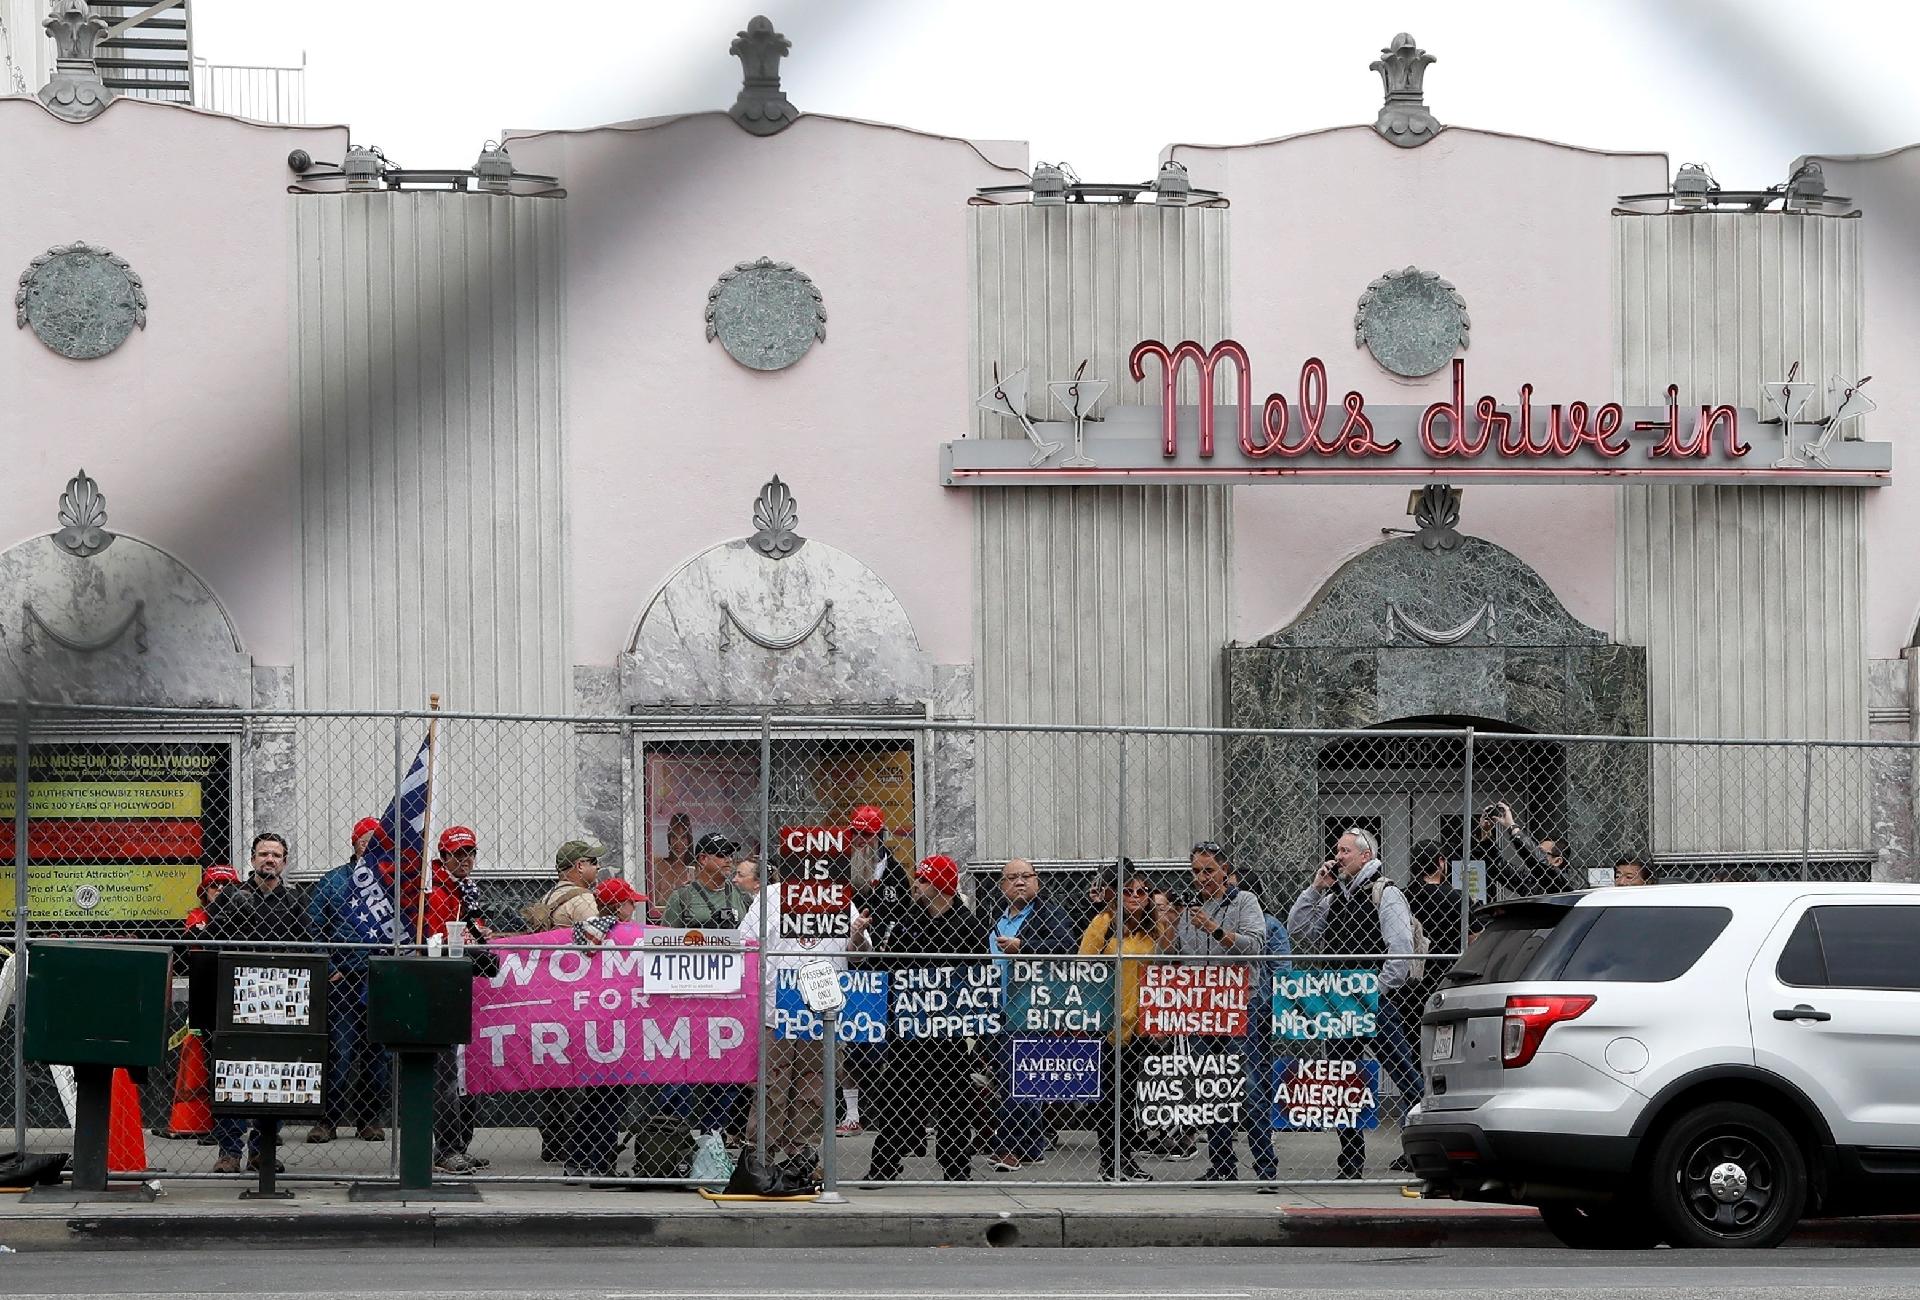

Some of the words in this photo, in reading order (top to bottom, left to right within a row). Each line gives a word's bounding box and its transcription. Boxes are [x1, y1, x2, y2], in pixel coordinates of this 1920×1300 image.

[1129, 339, 1402, 459] Mels
[1418, 358, 1753, 459] drive-in
[50, 755, 107, 768] MUSEUM
[111, 755, 128, 768] OF
[142, 769, 165, 778] Mayor
[37, 789, 88, 798] AUTHENTIC
[90, 789, 131, 798] SHOWBIZ
[134, 789, 184, 798] TREASURES
[51, 802, 68, 810] 100
[70, 802, 98, 810] YEARS
[100, 802, 112, 810] OF
[787, 830, 843, 853] CNN
[54, 871, 84, 879] Tourist
[156, 870, 186, 879] Weekly
[804, 858, 829, 880] IS
[31, 895, 65, 903] Tourism
[136, 894, 161, 902] Board
[45, 885, 54, 893] of
[787, 884, 843, 906] FAKE
[53, 909, 61, 917] of
[122, 909, 139, 918] Trip
[782, 913, 849, 935] NEWS
[651, 935, 731, 947] CALIFORNIANS
[650, 954, 733, 981] 4TRUMP
[802, 966, 833, 981] PASSENGER
[894, 967, 954, 990] SHUT
[967, 964, 1001, 987] UP
[1014, 961, 1044, 982] DE
[1050, 961, 1108, 983] NIRO
[1146, 965, 1244, 987] EPSTEIN
[779, 969, 883, 993] WOME
[810, 977, 833, 991] LOADING
[1272, 972, 1378, 1000] HOLLYWOOD
[573, 987, 651, 1011] FOR
[817, 989, 832, 1000] ONLY
[895, 990, 948, 1013] AND
[956, 987, 1001, 1009] ACT
[1031, 984, 1050, 1006] IS
[1064, 984, 1083, 1006] A
[1139, 986, 1206, 1010] DIDNT
[899, 1013, 1001, 1038] PUPPETS
[1026, 1009, 1101, 1031] BITCH
[1145, 1010, 1240, 1033] HIMSELF
[1272, 1009, 1376, 1040] HYPOCRITES
[480, 1016, 745, 1067] TRUMP
[1016, 1058, 1097, 1072] AMERICA
[1143, 1054, 1241, 1077] GERVAIS
[1298, 1058, 1356, 1081] KEEP
[1029, 1072, 1085, 1081] FIRST
[1137, 1080, 1184, 1102] WAS
[1195, 1077, 1246, 1099] 100%
[1273, 1083, 1376, 1109] AMERICA
[1142, 1102, 1242, 1127] CORRECT
[1288, 1106, 1362, 1129] GREAT
